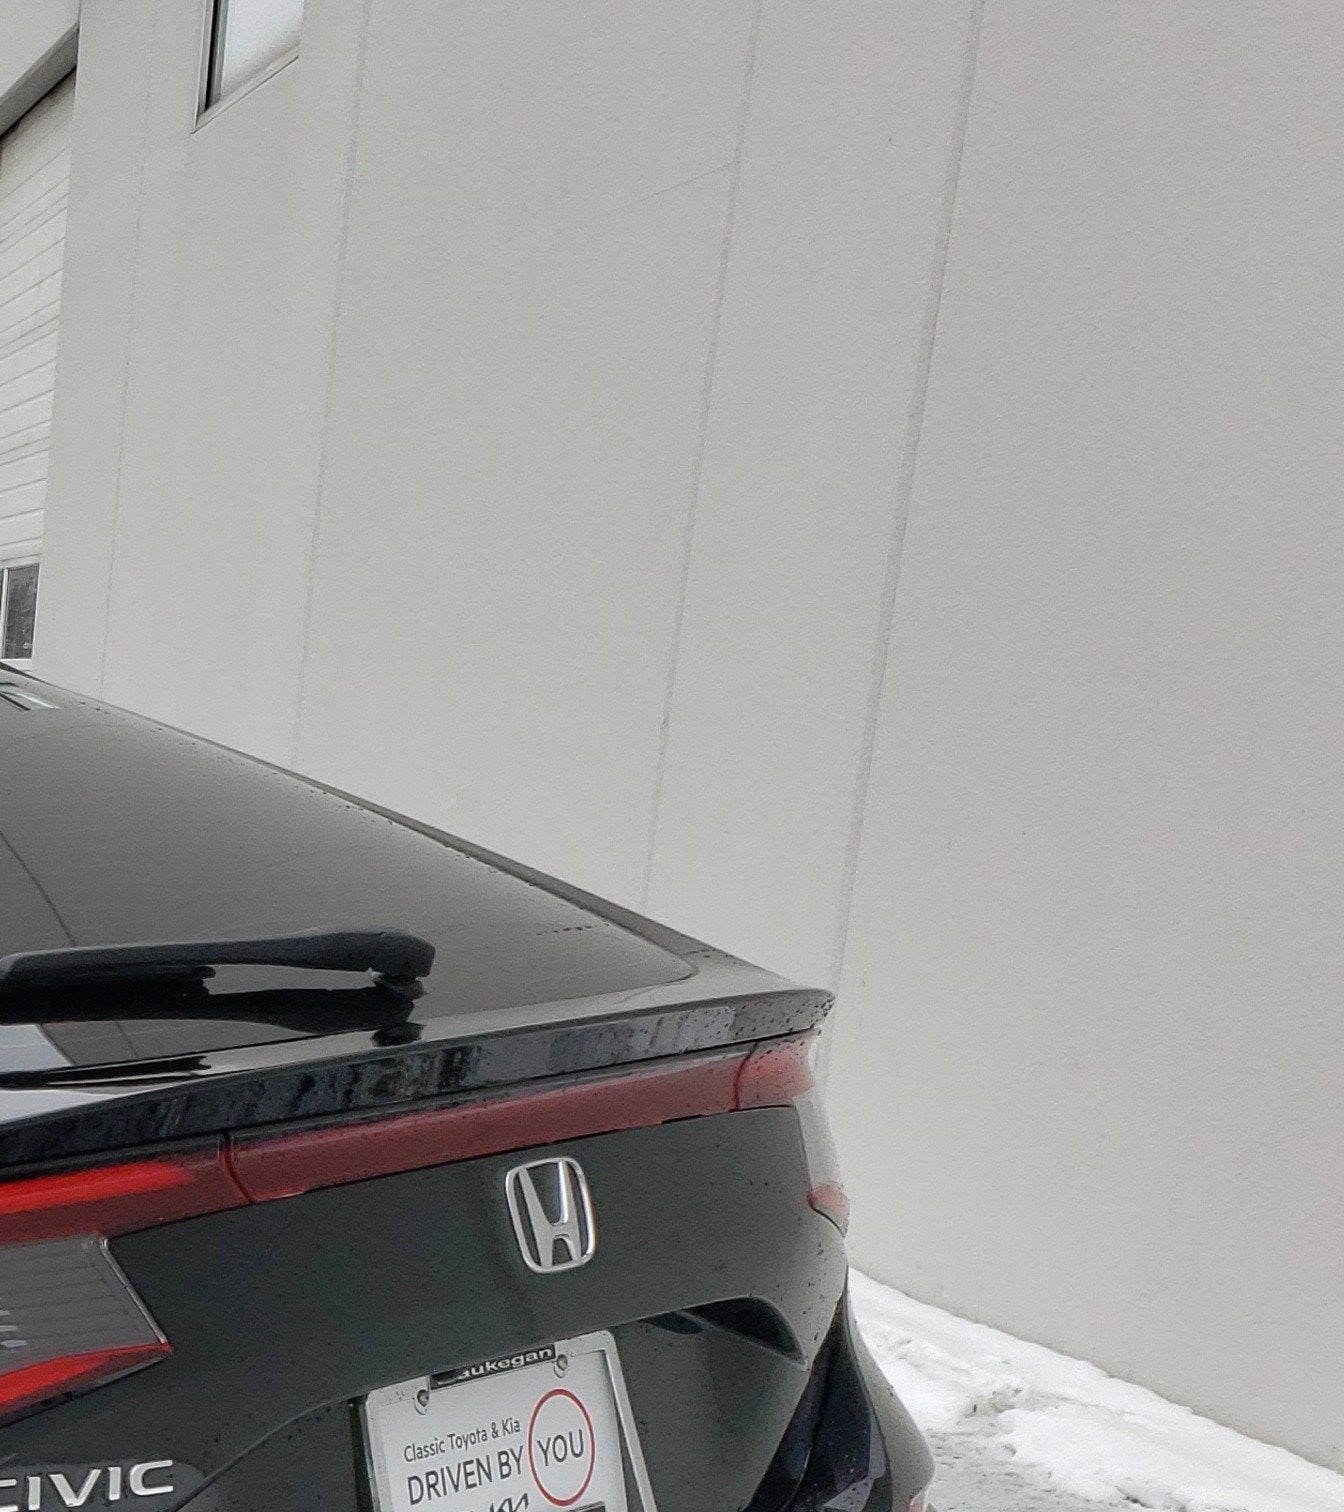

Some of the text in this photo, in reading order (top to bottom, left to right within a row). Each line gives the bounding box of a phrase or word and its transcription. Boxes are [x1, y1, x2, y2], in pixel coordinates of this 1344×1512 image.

[437, 1347, 553, 1385] aukegan
[403, 1417, 521, 1463] Classic Toyota & Kia
[407, 1429, 584, 1506] DRIVEN BY YOU
